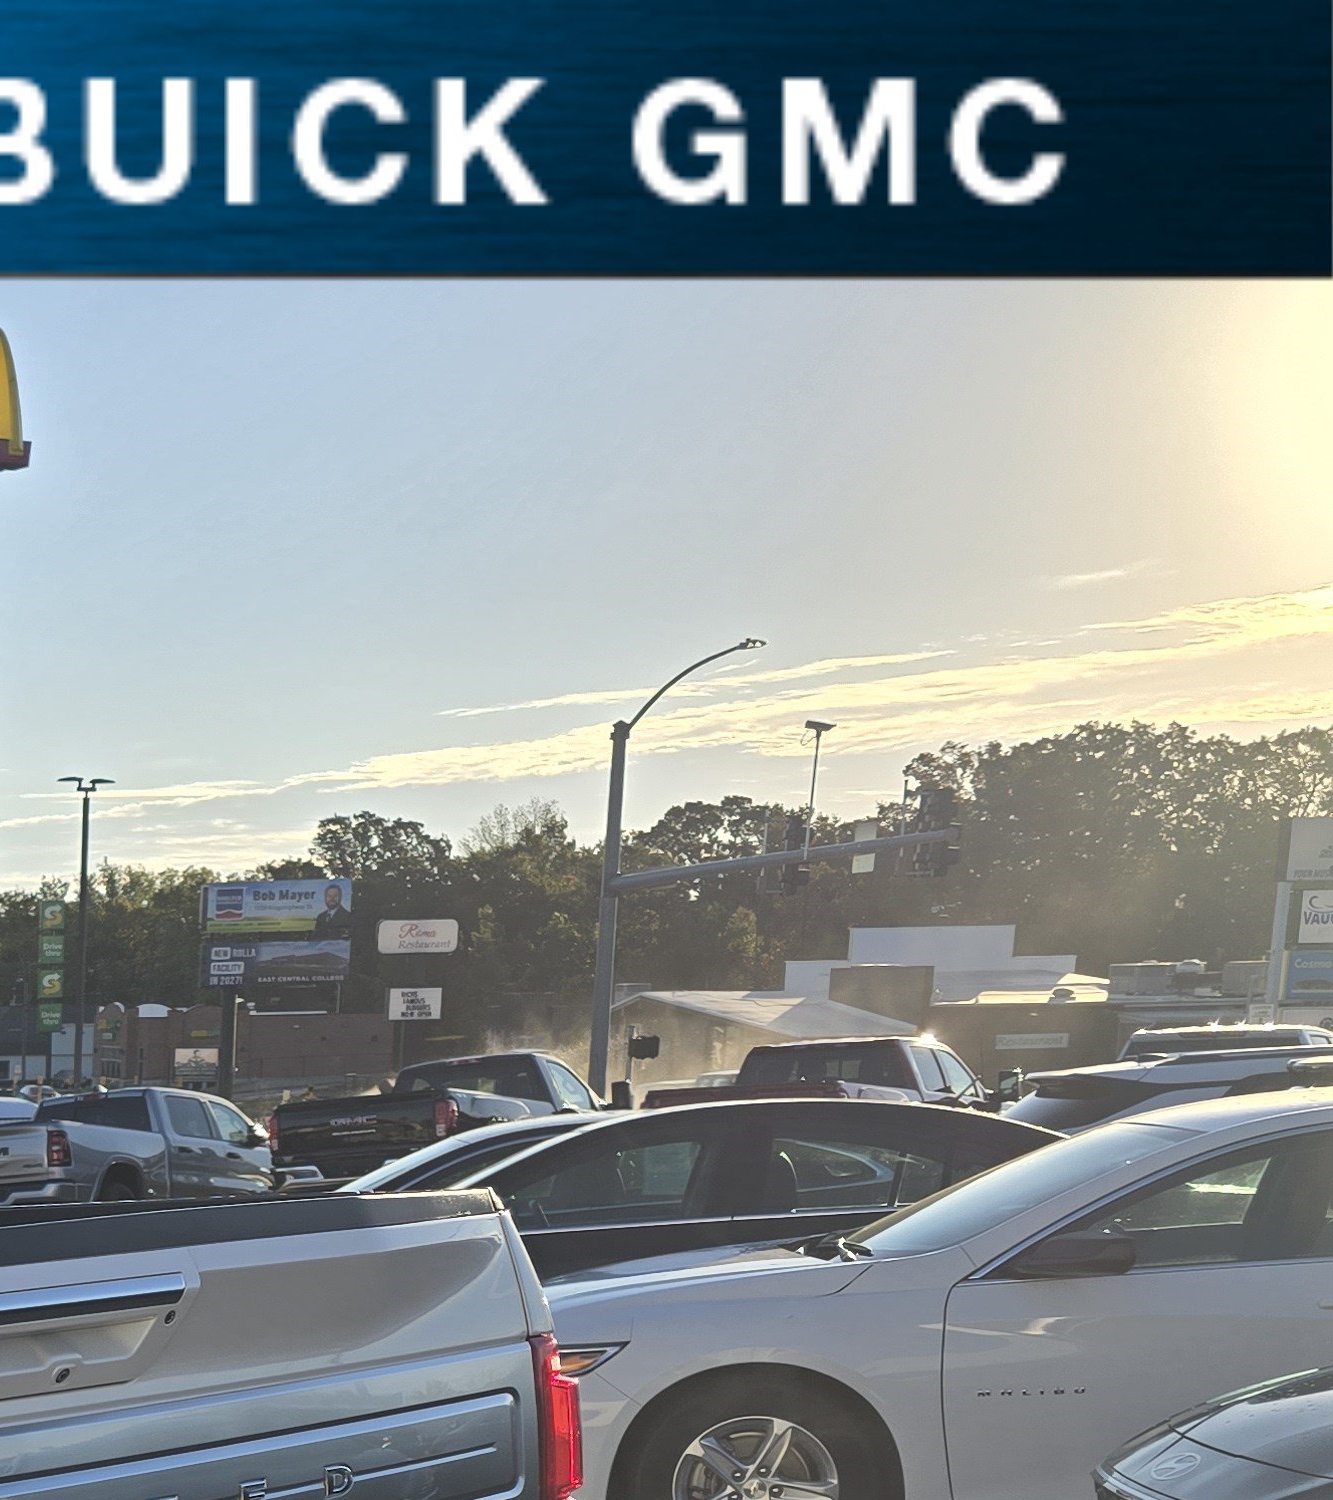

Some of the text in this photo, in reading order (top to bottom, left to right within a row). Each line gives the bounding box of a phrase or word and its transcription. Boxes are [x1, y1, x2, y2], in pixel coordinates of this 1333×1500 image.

[252, 889, 276, 901] Bob
[278, 889, 316, 903] Mayer
[43, 943, 63, 951] Drive
[398, 940, 452, 950] Restaurant
[277, 975, 310, 983] CENTRAL
[41, 1011, 61, 1019] Drive
[976, 1385, 1086, 1398] MALIBU
